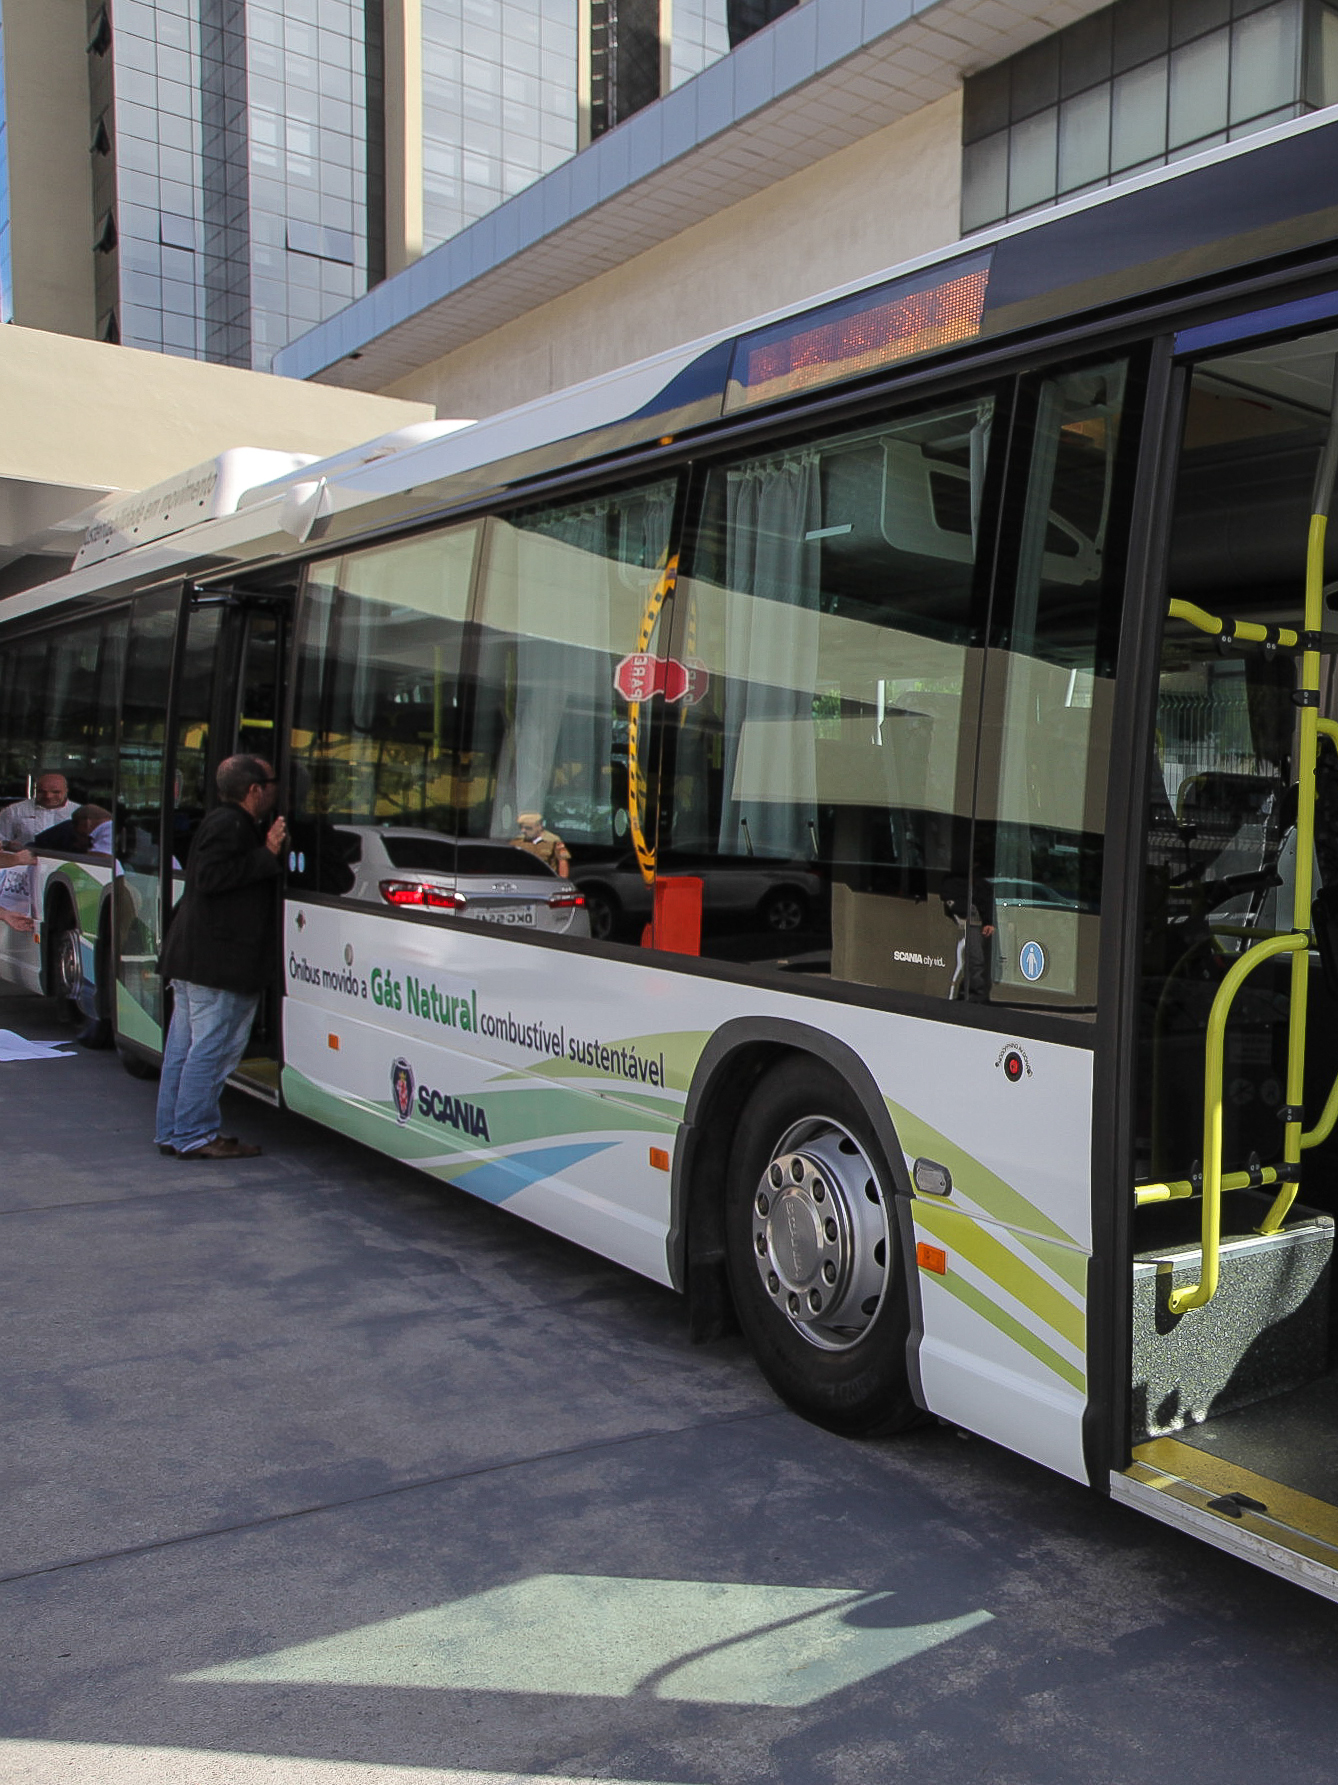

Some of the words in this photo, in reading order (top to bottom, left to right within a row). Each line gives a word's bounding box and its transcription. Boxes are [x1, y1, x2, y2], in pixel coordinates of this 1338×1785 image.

[893, 950, 923, 964] SCANIA
[289, 951, 321, 987] Ônibus
[322, 969, 359, 998] movido
[361, 981, 368, 999] a
[370, 966, 402, 1011] Gás
[406, 975, 478, 1033] Natural
[480, 1011, 565, 1058] combustível
[568, 1036, 665, 1089] sustentável
[418, 1084, 491, 1142] SCANIA
